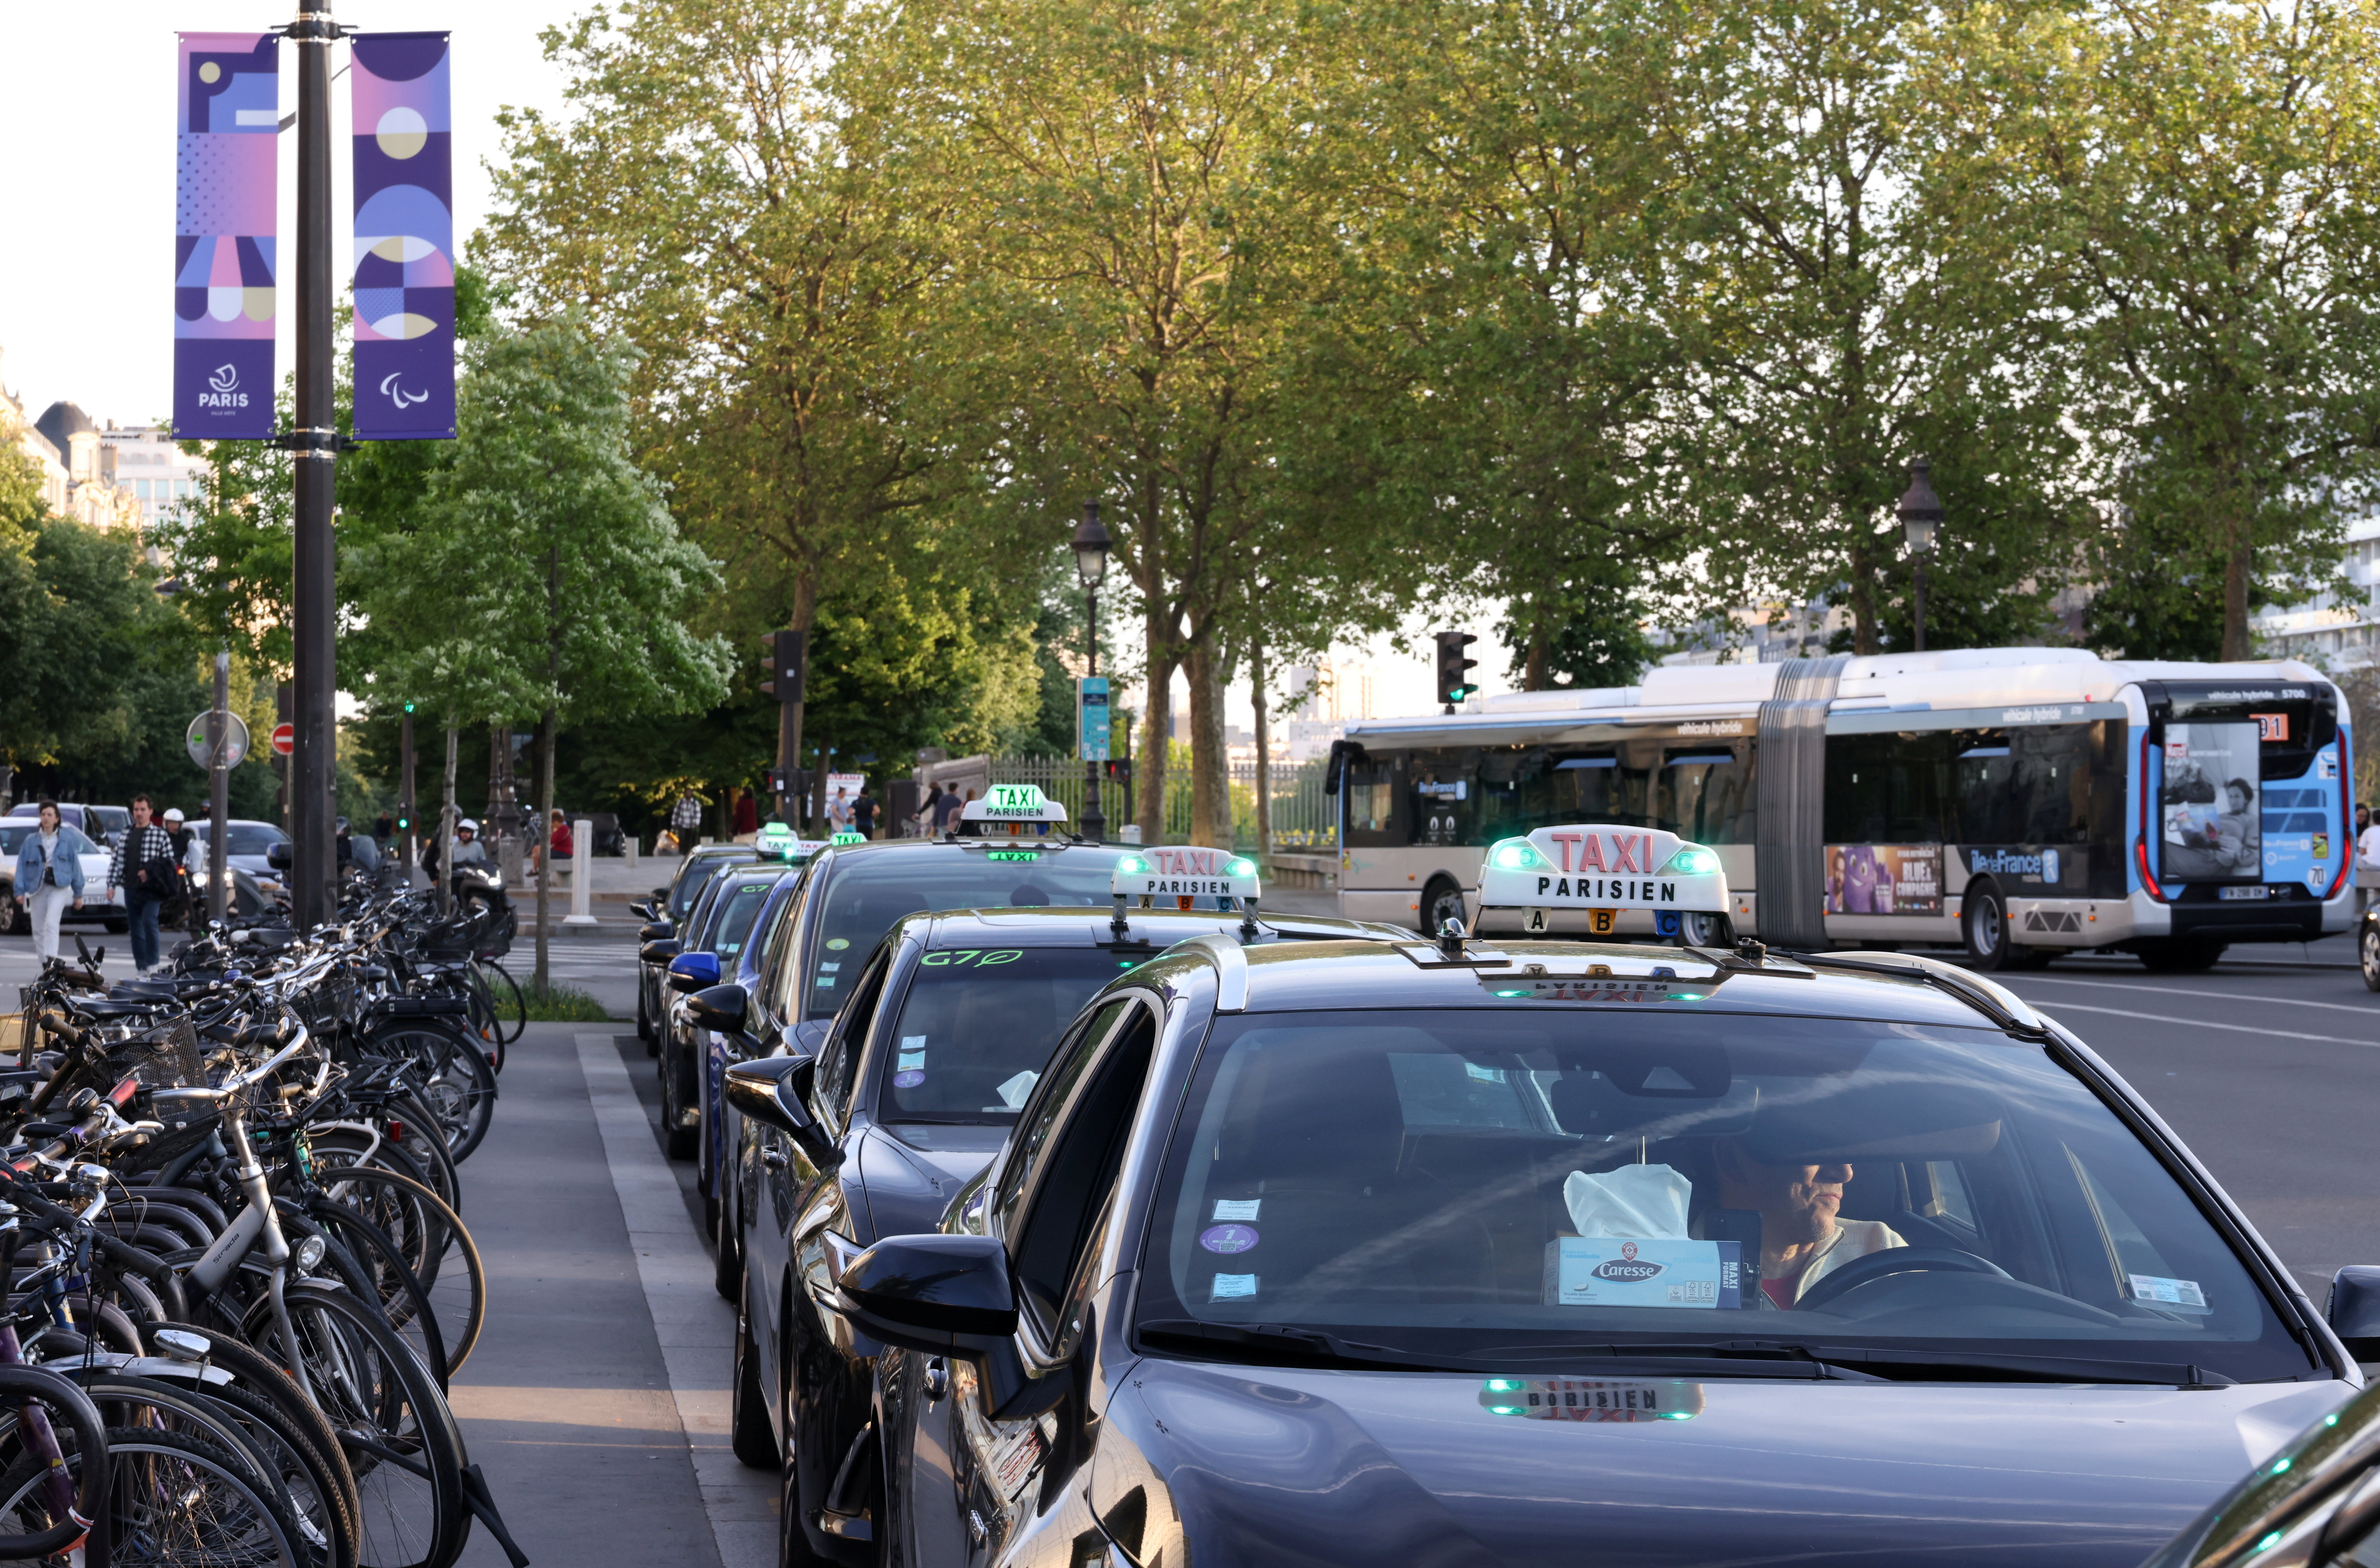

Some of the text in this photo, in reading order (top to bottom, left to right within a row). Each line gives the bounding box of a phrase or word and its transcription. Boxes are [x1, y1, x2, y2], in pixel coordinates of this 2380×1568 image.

[199, 393, 248, 407] PARIS
[2207, 689, 2305, 700] véhicule hybride 5700
[1711, 721, 1743, 736] hybride
[996, 789, 1035, 806] TAXI
[986, 808, 1043, 816] PARISIEN
[837, 835, 861, 845] TAXI
[1552, 834, 1653, 873] TAXI
[1155, 851, 1216, 874] TAXI
[1902, 862, 1927, 881] BLUE
[2311, 868, 2324, 884] 70
[742, 884, 769, 893] G7
[1148, 881, 1230, 893] PARISIEN
[1538, 877, 1675, 902] PARISIEN
[1896, 882, 1937, 896] COMPAGNIE
[1142, 897, 1229, 910] A B C
[1531, 911, 1676, 933] A B C
[921, 950, 982, 965] G7
[1225, 1230, 1236, 1240] 1
[213, 1233, 239, 1264] Strada
[1599, 1263, 1654, 1277] Caresse
[1729, 1262, 1737, 1289] MAXI
